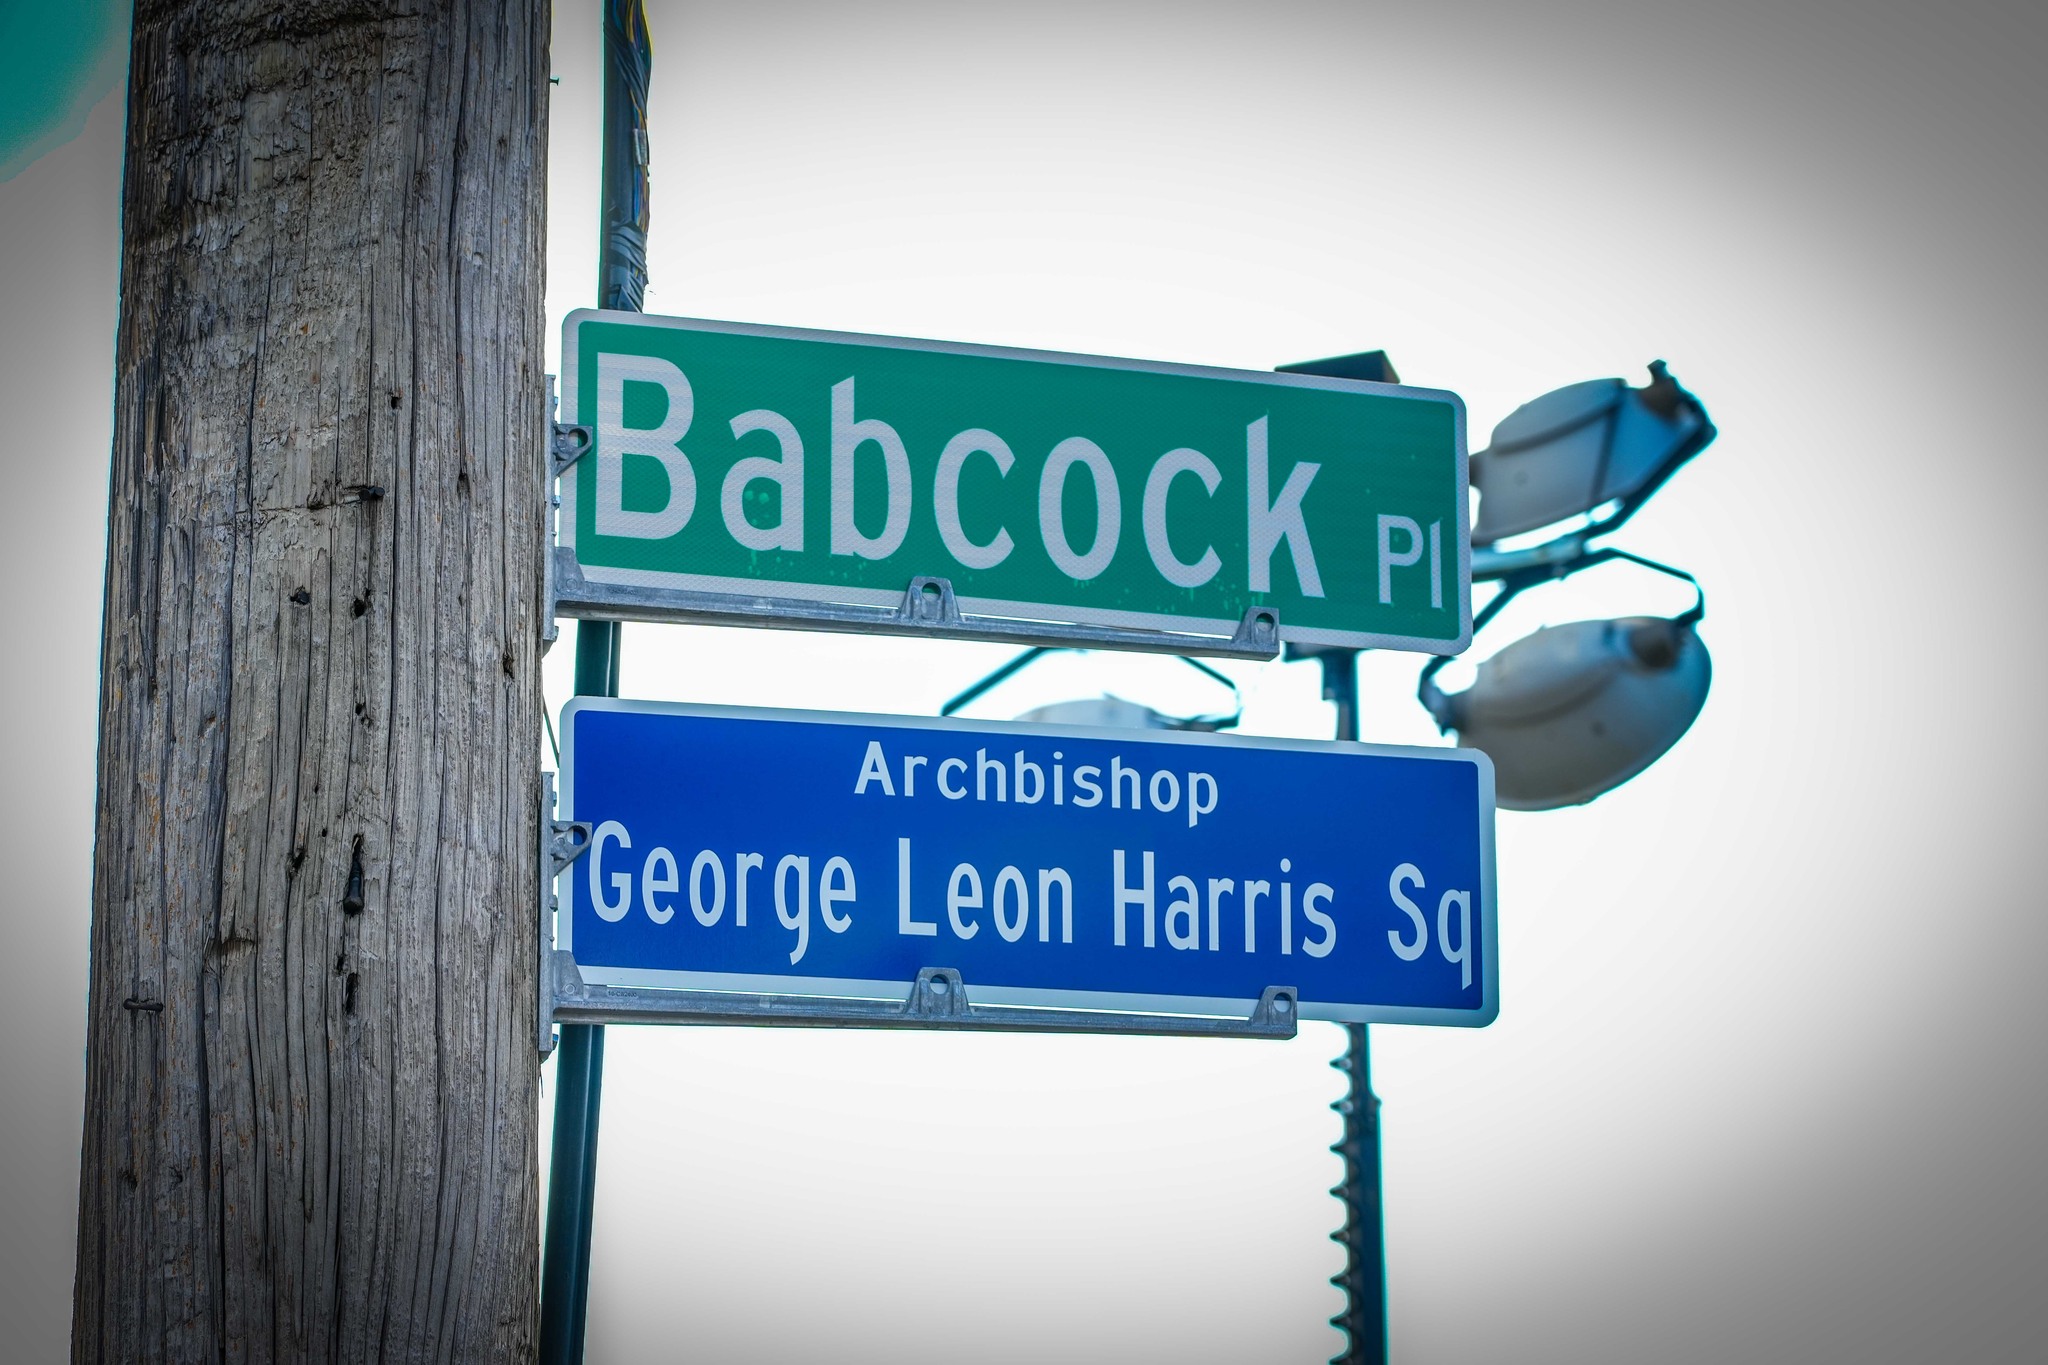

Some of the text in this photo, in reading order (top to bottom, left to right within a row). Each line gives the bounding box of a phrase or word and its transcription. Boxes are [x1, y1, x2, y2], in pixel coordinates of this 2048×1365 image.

[594, 352, 1325, 600] Babcock
[854, 740, 1219, 828] Archbishop
[588, 819, 1473, 991] George Leon Harris Sq
